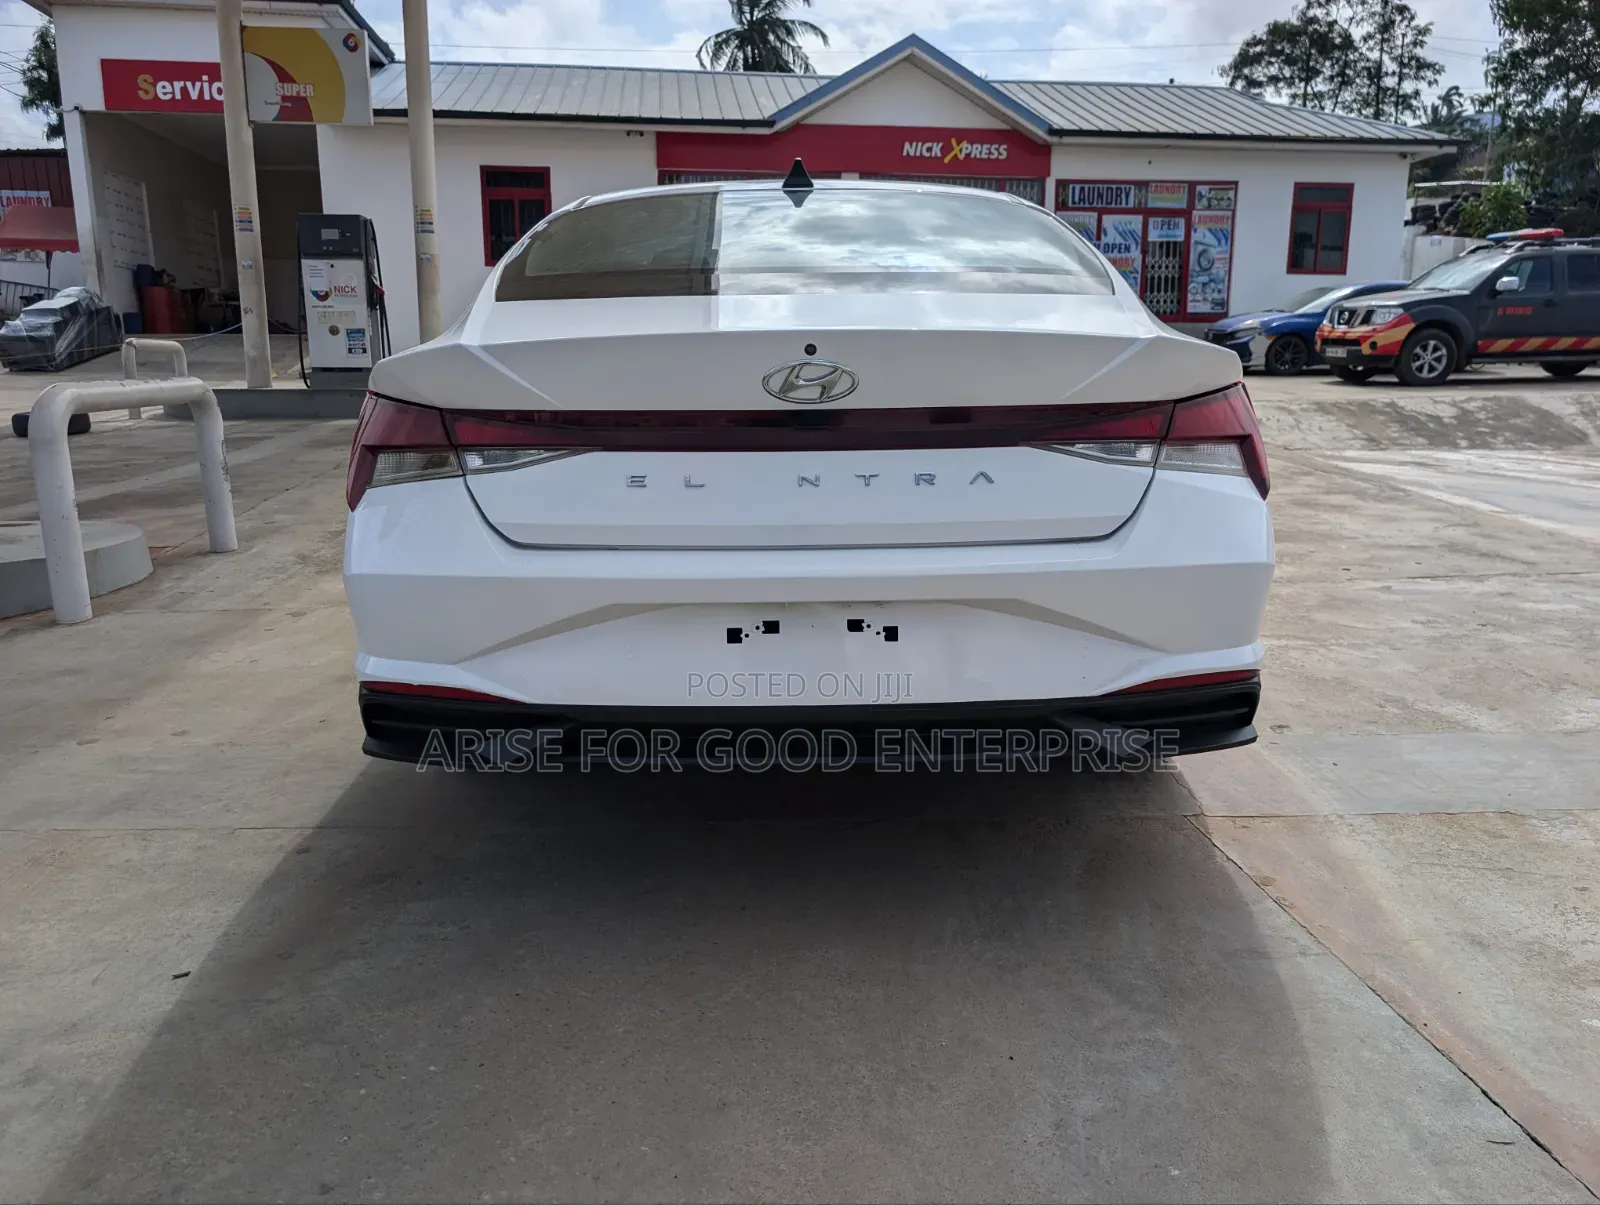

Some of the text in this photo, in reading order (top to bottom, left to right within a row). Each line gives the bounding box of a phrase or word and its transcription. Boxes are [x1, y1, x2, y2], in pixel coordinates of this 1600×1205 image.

[137, 74, 225, 101] Servic
[276, 82, 314, 97] SUPER
[902, 137, 1008, 164] NICK XPRESS
[1071, 186, 1132, 206] LAUNDRY
[1152, 219, 1180, 230] OPEN
[1103, 242, 1131, 254] OPEN
[333, 285, 357, 294] NICK
